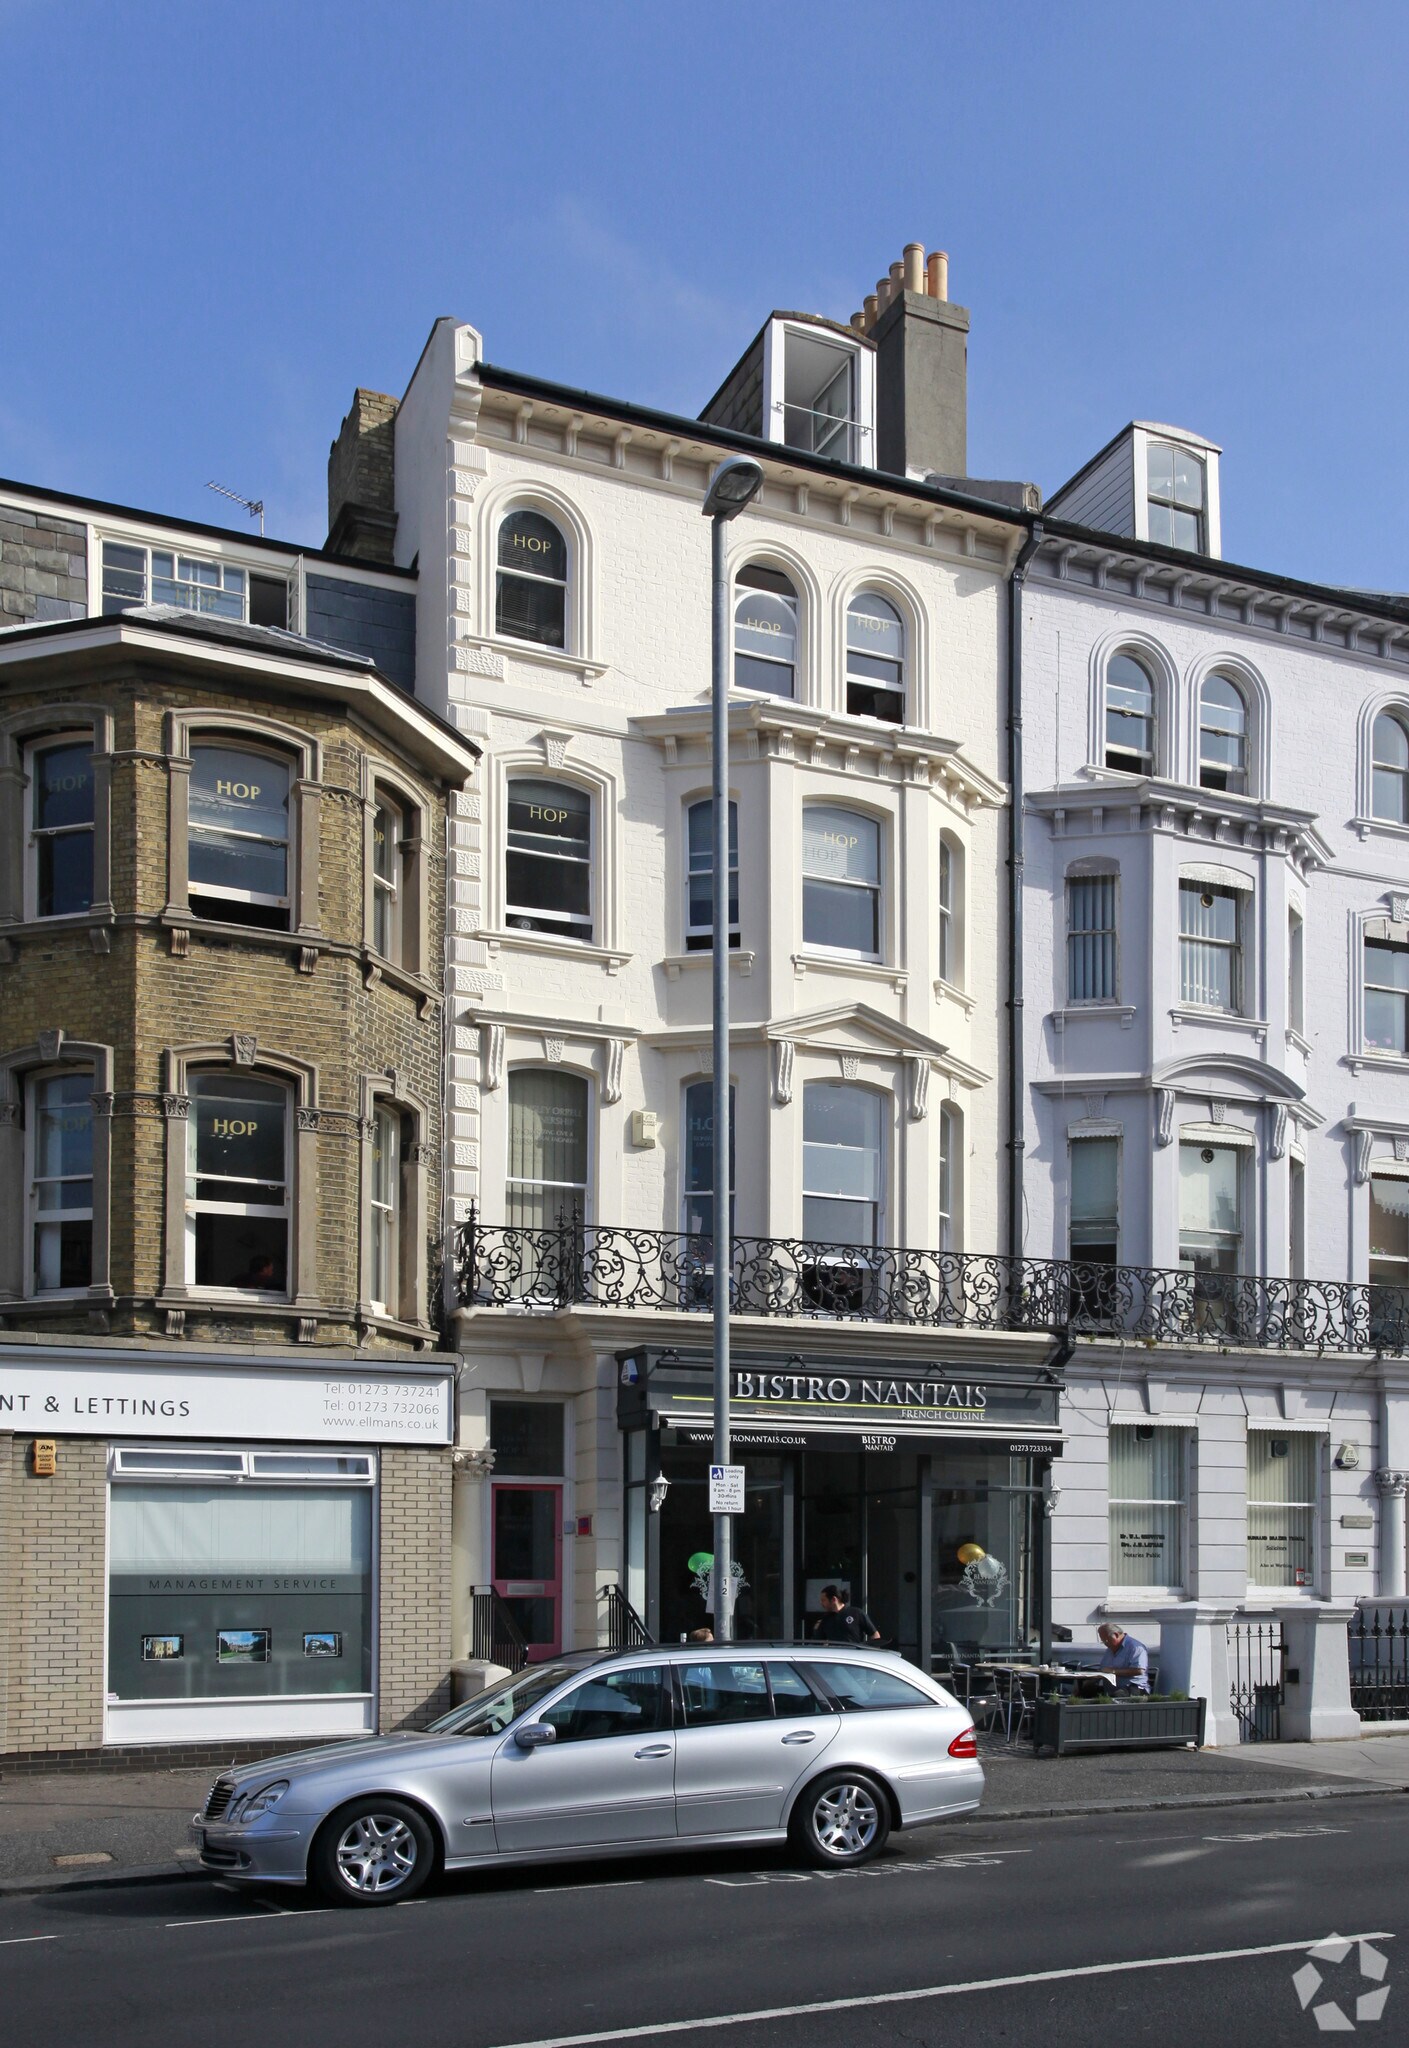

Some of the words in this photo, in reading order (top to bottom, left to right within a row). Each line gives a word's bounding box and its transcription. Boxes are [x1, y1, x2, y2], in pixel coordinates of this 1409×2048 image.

[513, 533, 552, 553] HOP
[747, 617, 781, 634] HOP
[857, 615, 890, 632] HOP
[48, 774, 87, 793] HOP
[217, 780, 261, 800] HOP
[530, 806, 568, 823] HOP
[824, 832, 858, 848] HOP
[213, 1118, 258, 1136] HOP
[323, 1383, 345, 1394] Tel:
[348, 1384, 389, 1396] 01273
[394, 1386, 440, 1398] 737241
[735, 1372, 851, 1402] BISTRO
[860, 1380, 988, 1408] NANTAIS
[0, 1394, 31, 1411] NT
[44, 1396, 60, 1413] &
[74, 1397, 191, 1417] LETTINGS
[323, 1400, 344, 1411] Tel:
[347, 1400, 388, 1413] 01273
[392, 1402, 440, 1415] 732066
[323, 1416, 439, 1430] www.ellmans.co.uk
[902, 1409, 942, 1420] FRENCH
[944, 1411, 986, 1422] CUISINE
[862, 1435, 897, 1446] BISTRO
[865, 1444, 894, 1452] NANTAIS
[1010, 1444, 1029, 1452] 01273
[1029, 1445, 1053, 1453] 723334
[149, 1579, 265, 1590] MANAGEMENT
[273, 1578, 337, 1589] SERVICE
[723, 1578, 727, 1586] 1
[721, 1587, 728, 1596] 2
[703, 1856, 1004, 1887] LOADING
